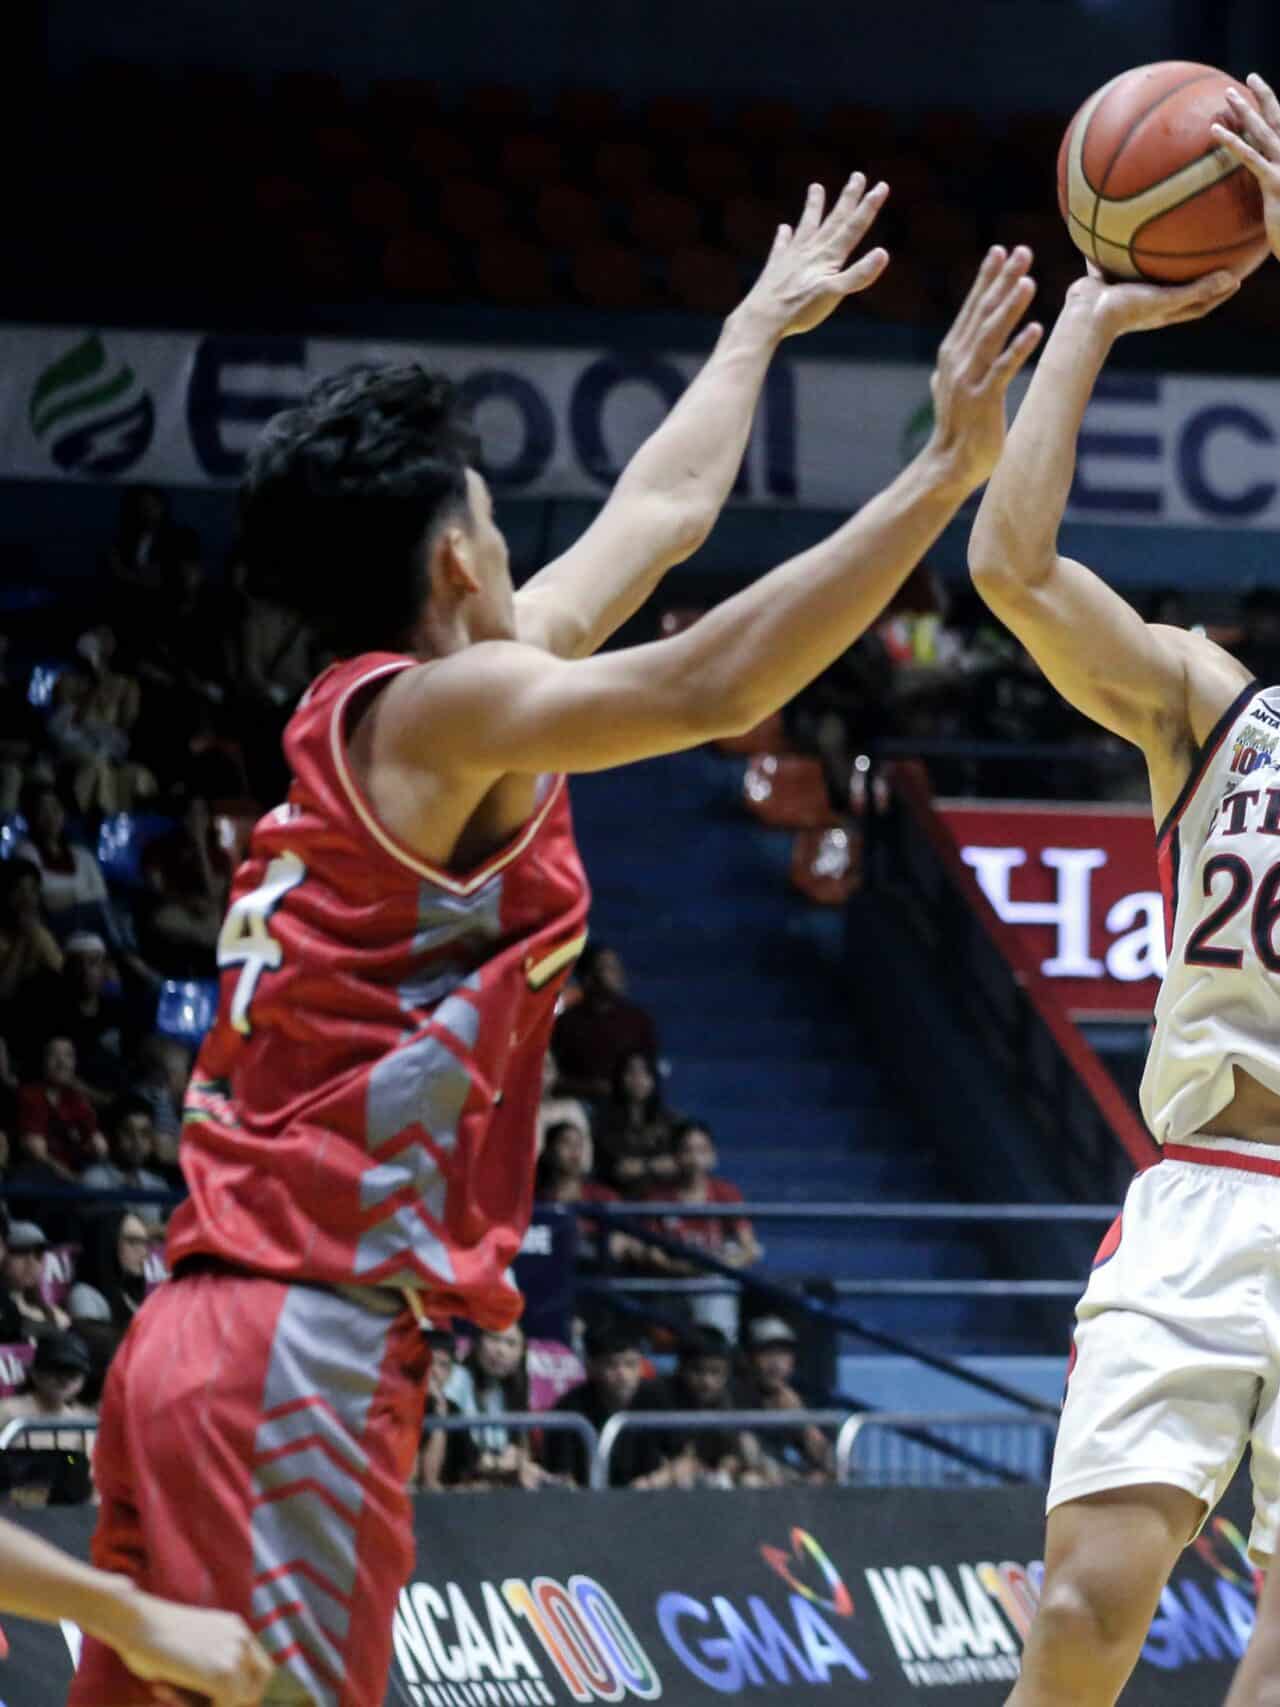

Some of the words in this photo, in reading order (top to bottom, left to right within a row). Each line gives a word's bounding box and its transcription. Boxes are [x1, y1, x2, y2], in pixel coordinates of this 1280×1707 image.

[1250, 708, 1280, 730] ANTA
[216, 848, 307, 1036] 4
[392, 1581, 544, 1684] NCAA
[501, 1574, 662, 1702] 100
[656, 1591, 871, 1694] GMA
[864, 1564, 1020, 1660] NCAA
[975, 1560, 1045, 1640] 10
